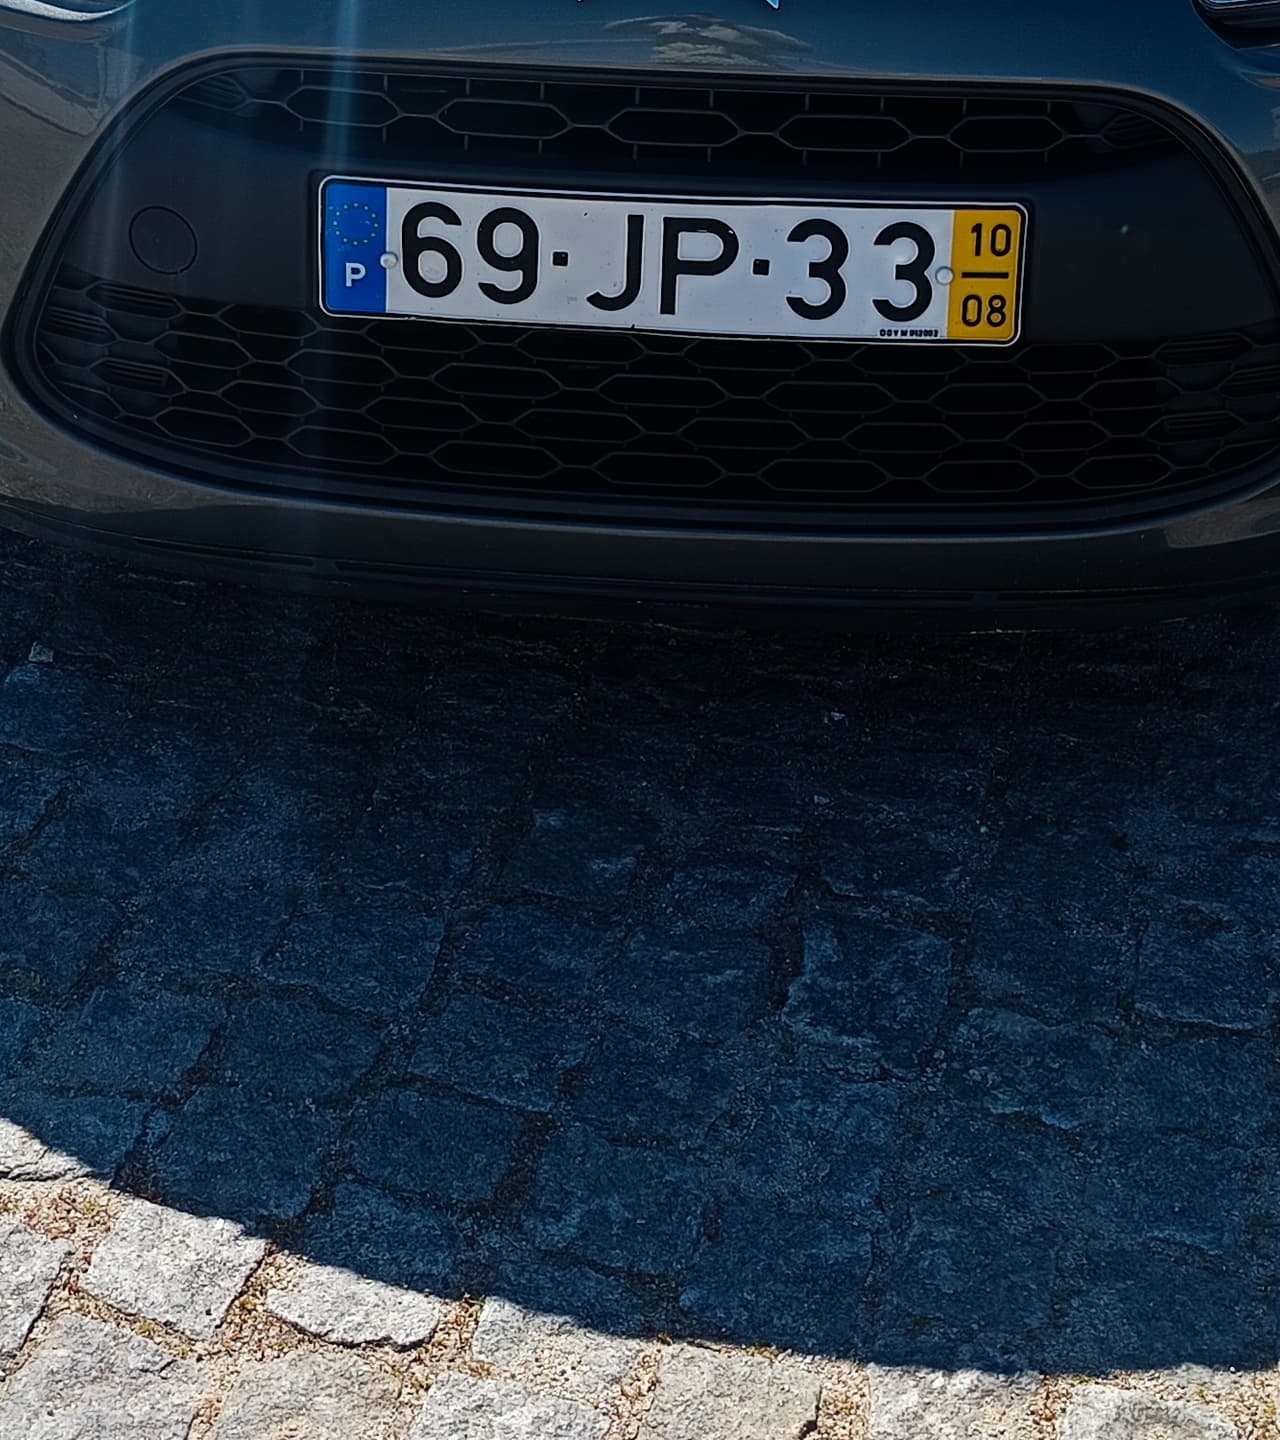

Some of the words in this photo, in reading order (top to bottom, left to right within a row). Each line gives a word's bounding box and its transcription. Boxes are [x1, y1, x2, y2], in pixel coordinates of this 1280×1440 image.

[971, 223, 1012, 257] 10
[344, 262, 367, 287] P
[961, 294, 1007, 328] 08
